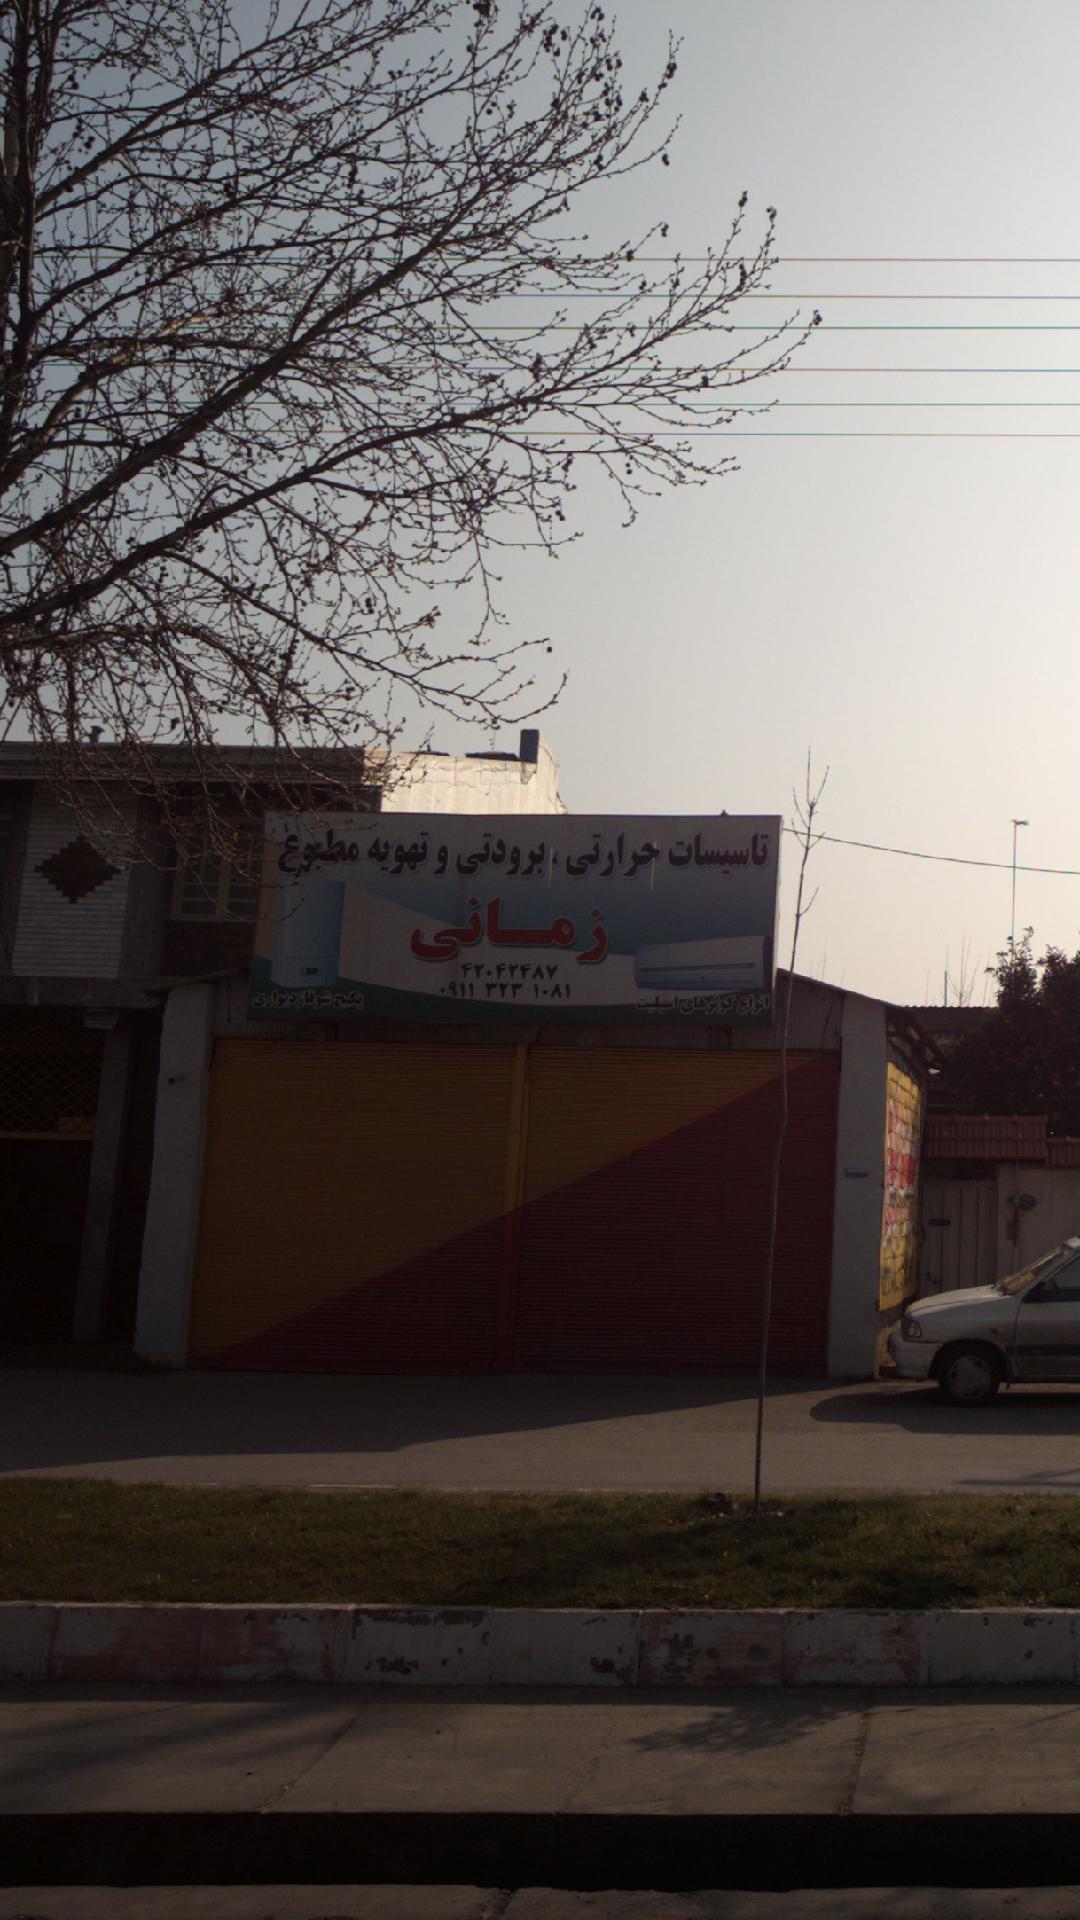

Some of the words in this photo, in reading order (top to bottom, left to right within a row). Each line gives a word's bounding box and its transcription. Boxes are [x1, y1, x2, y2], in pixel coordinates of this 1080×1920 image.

[368, 831, 429, 875] تهویه
[433, 845, 449, 875] و
[456, 832, 545, 876] برودتی
[566, 832, 660, 877] حرارتی
[668, 832, 769, 876] تاسیسات
[411, 896, 608, 963] زمانی
